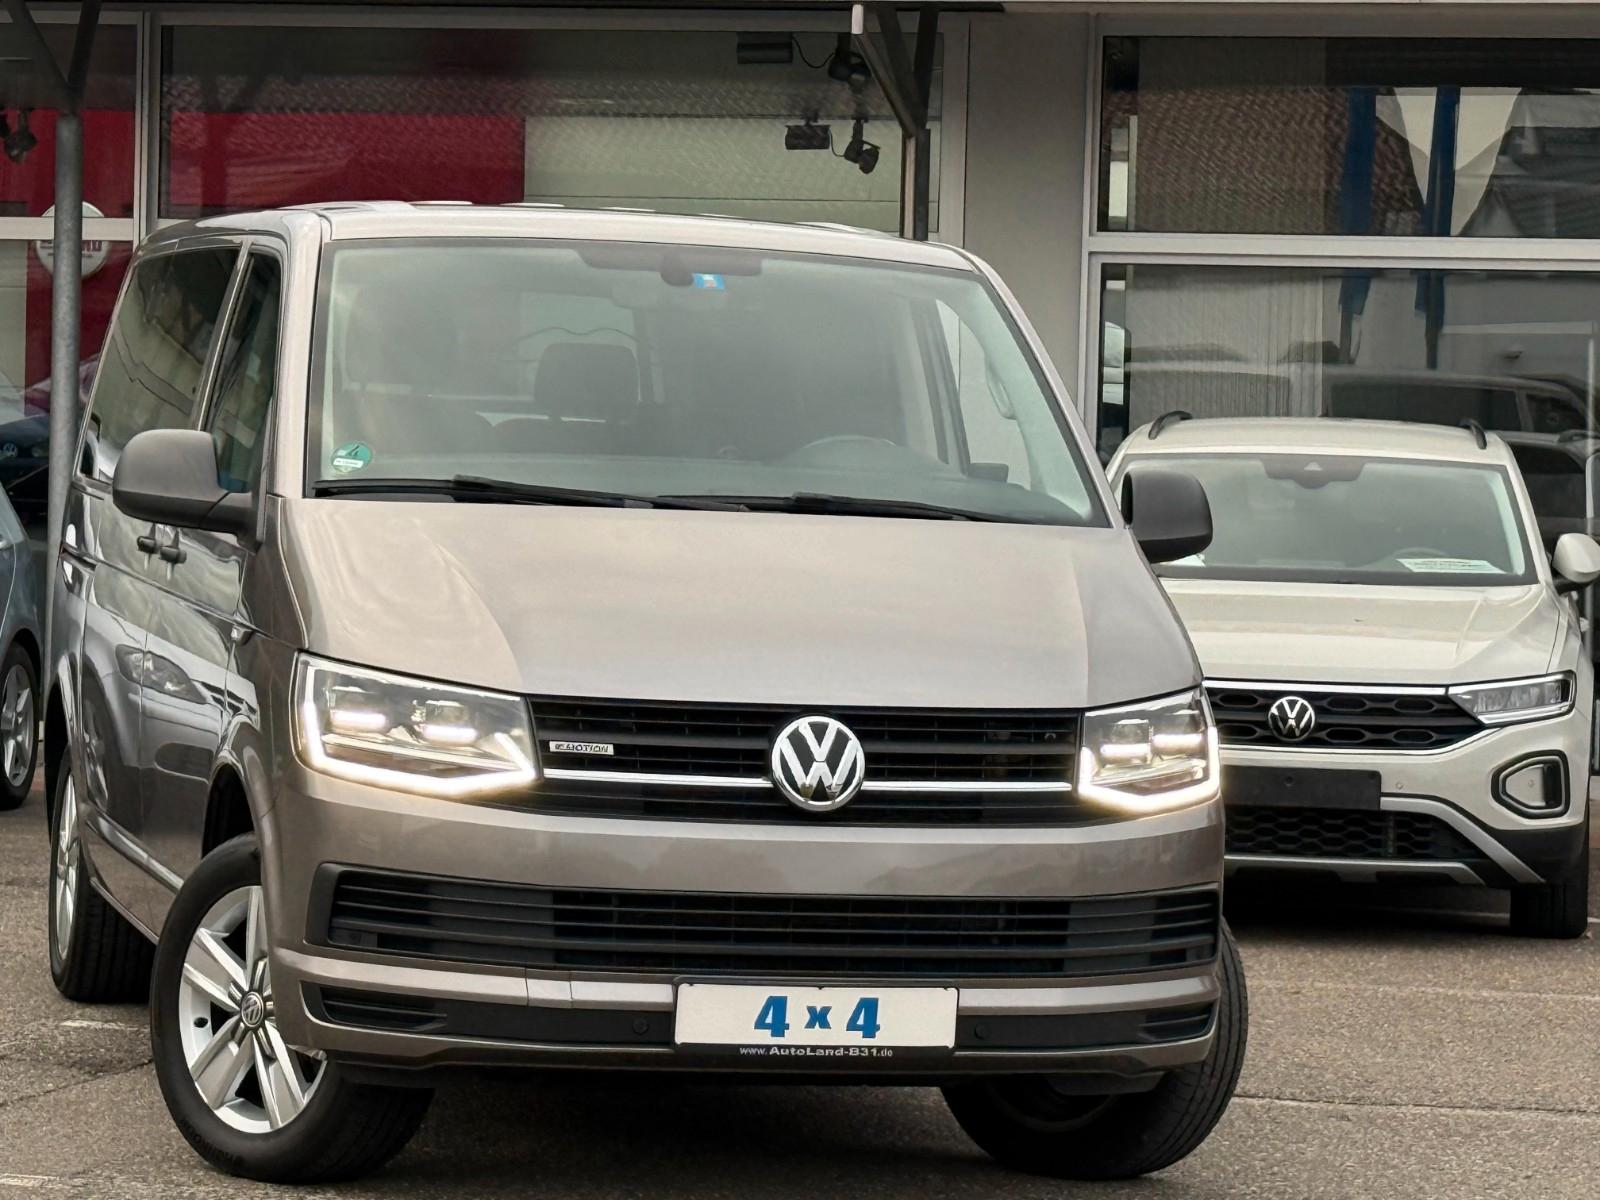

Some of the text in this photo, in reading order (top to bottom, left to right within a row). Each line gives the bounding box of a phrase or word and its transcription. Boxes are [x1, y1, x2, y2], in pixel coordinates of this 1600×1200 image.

[773, 717, 863, 808] VW
[754, 995, 881, 1038] 4 x 4
